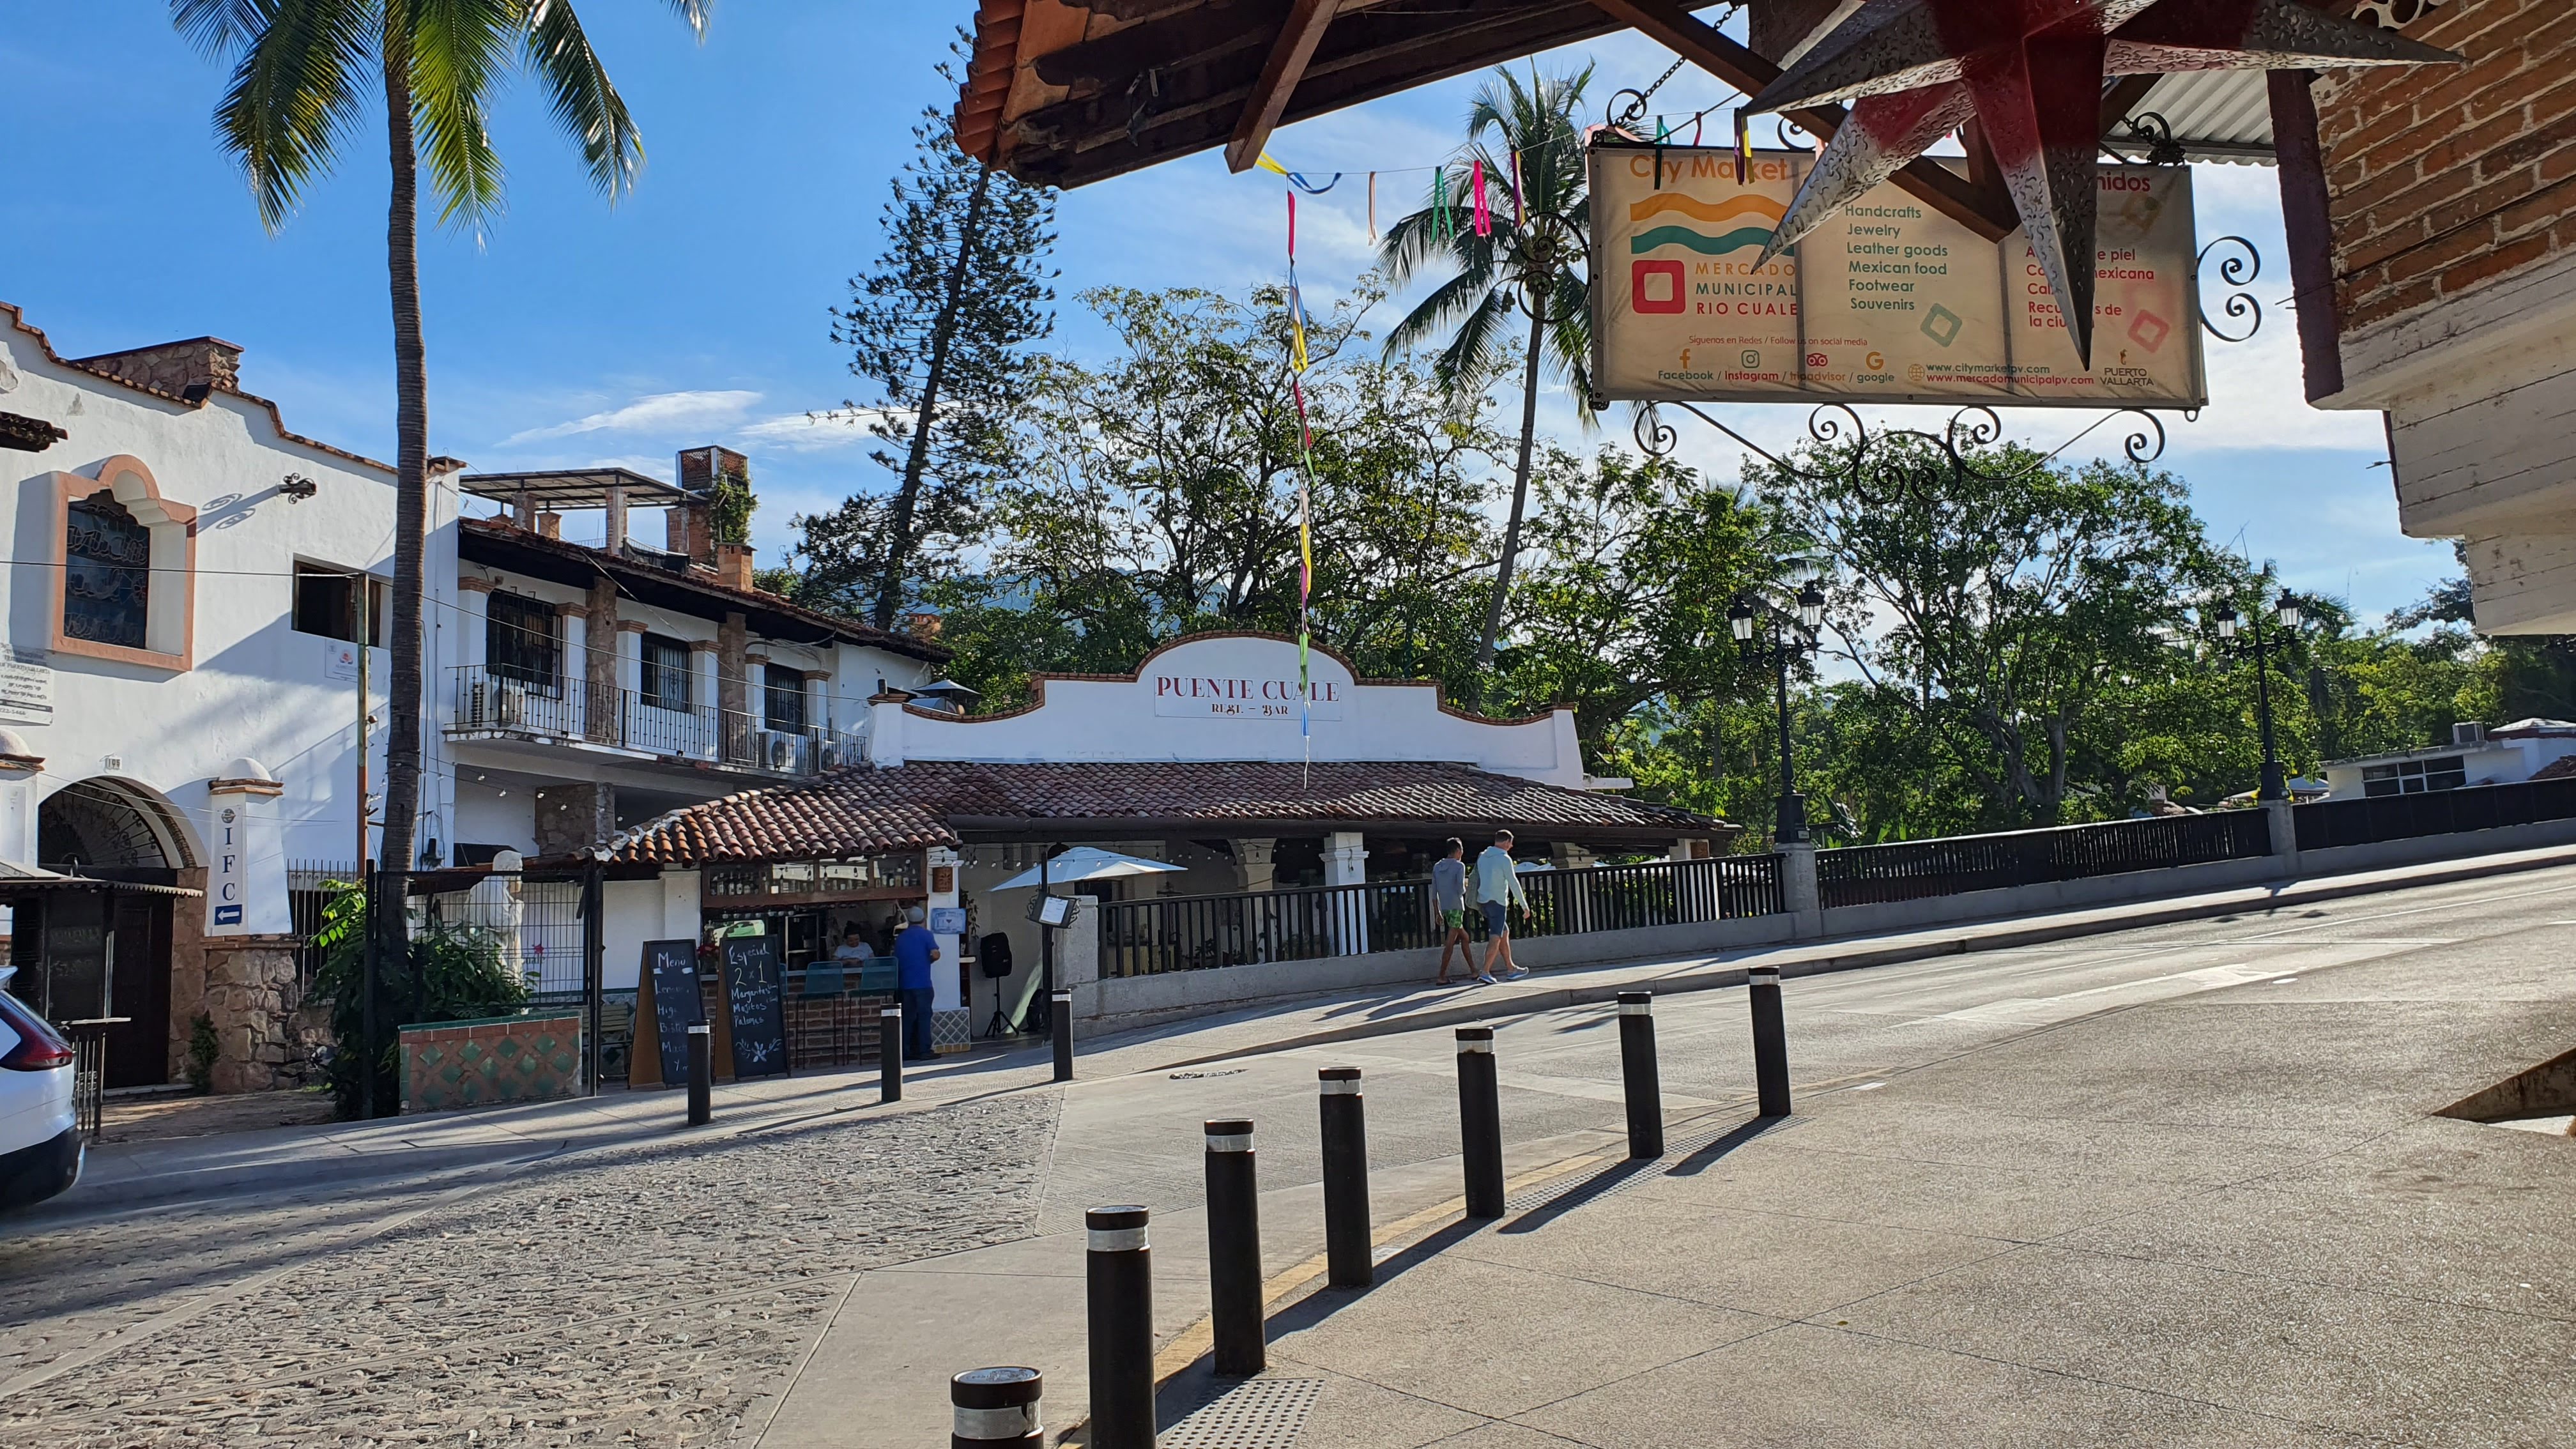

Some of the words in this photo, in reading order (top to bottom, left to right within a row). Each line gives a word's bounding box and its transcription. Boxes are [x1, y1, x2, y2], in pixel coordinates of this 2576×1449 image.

[1691, 155, 1788, 180] Maket
[1845, 204, 1922, 218] Handcrafts
[1847, 224, 1901, 239] Jewelry
[1847, 242, 1899, 254] Leather
[1904, 245, 1948, 258] goods
[2111, 249, 2136, 263] piel
[1695, 263, 1795, 276] MERCADO
[1848, 261, 1911, 273] Mexican
[1914, 262, 1947, 275] food
[1696, 283, 1797, 296] MUNICIPAL
[1848, 279, 1914, 291] Footwear
[1697, 302, 1728, 314] RIO
[1737, 302, 1798, 315] CUALE
[1850, 298, 1915, 310] Souvenirs
[2105, 304, 2122, 316] de
[2030, 315, 2042, 327] la
[1926, 363, 2050, 375] www.citymarketpv.com
[2104, 367, 2147, 377] PUERTO
[1658, 371, 1713, 380] Facebook
[1725, 371, 1779, 381] Instagram
[1790, 371, 1846, 381] tripadvisor
[1857, 372, 1895, 383] google
[1926, 374, 2094, 386] www.mercadomunicipalpv.com
[2099, 377, 2154, 387] VALLARTA
[1156, 677, 1254, 699] PUENTE
[1262, 680, 1340, 702] CUALE
[1262, 705, 1289, 716] BAR
[729, 943, 770, 965] Especial
[735, 967, 747, 985] 2
[758, 961, 767, 983] 1
[733, 1002, 767, 1013] Mojitos
